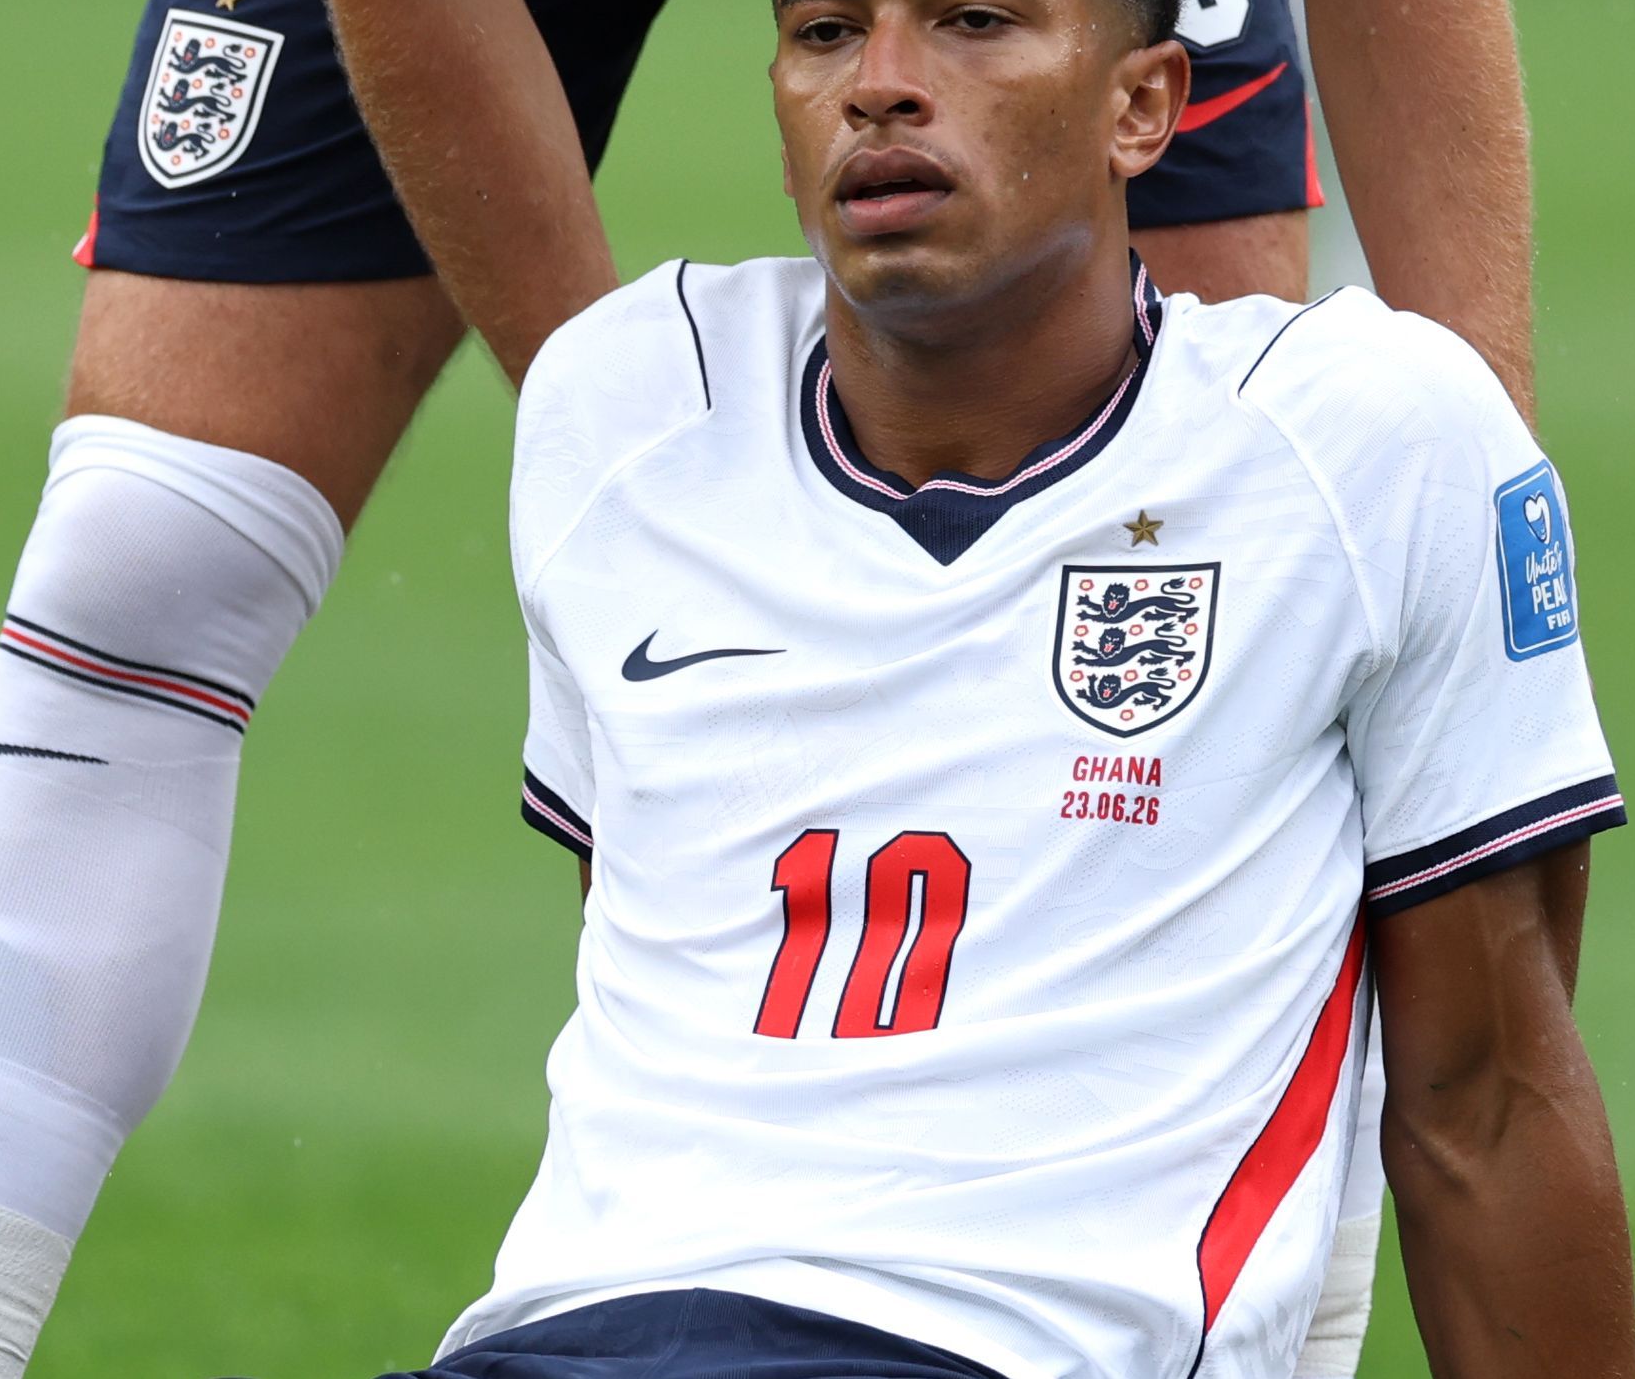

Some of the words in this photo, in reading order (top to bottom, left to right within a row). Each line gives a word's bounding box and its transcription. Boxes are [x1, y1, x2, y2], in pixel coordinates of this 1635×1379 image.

[1532, 573, 1568, 614] PEA
[1072, 756, 1161, 787] GHANA
[1060, 791, 1160, 826] 23.06.26
[753, 829, 972, 1039] 10
